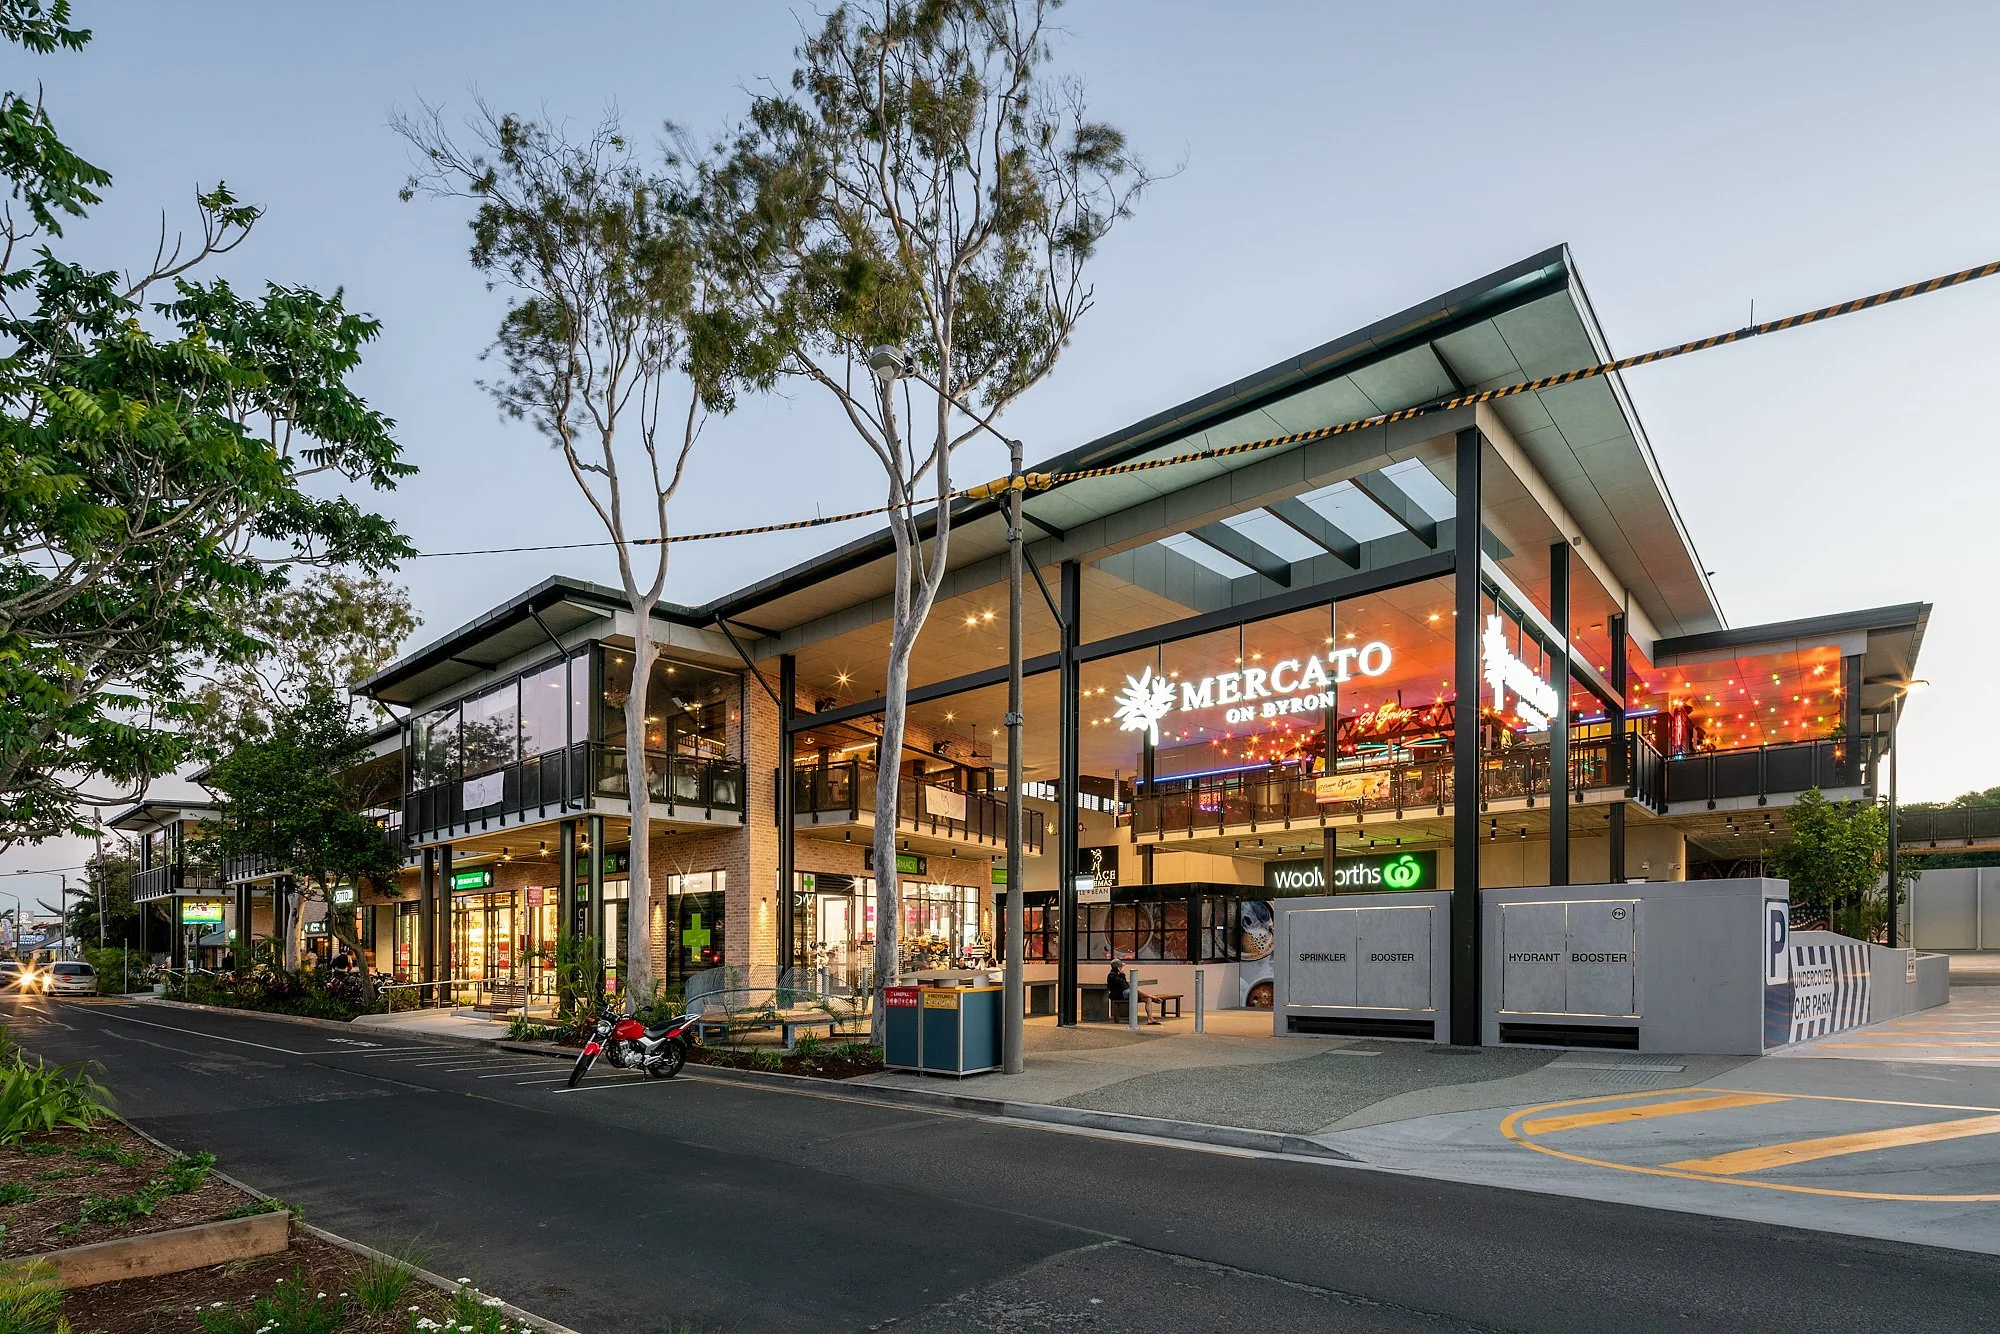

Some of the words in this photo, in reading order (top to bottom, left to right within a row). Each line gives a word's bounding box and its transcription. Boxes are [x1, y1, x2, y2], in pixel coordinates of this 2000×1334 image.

[1181, 641, 1392, 711] MERCATO
[1226, 706, 1256, 724] ON
[1262, 691, 1335, 718] BYRON
[1093, 879, 1113, 887] EMAS
[1770, 909, 1786, 978] P
[1299, 953, 1346, 962] SPRINKLER
[1371, 953, 1415, 962] BOOSTER
[1508, 953, 1560, 962] HYDRANT
[1571, 953, 1628, 963] BOOSTER
[1794, 968, 1832, 989] UNDERCOVER
[1794, 995, 1811, 1020] CAR
[1812, 992, 1832, 1016] PARK
